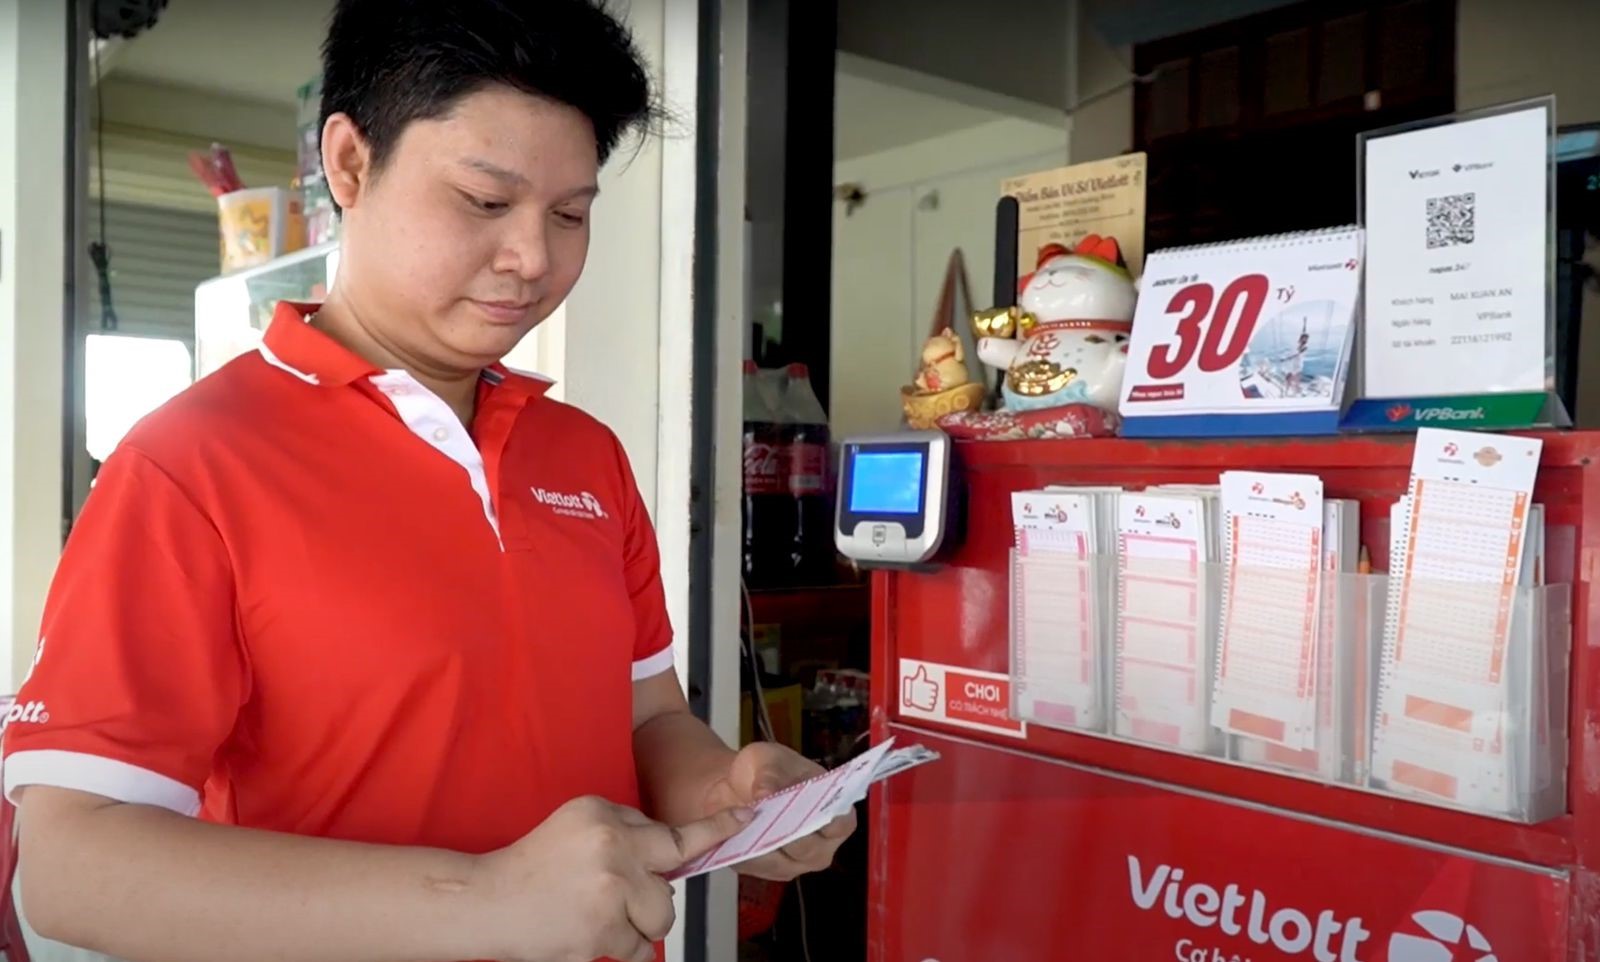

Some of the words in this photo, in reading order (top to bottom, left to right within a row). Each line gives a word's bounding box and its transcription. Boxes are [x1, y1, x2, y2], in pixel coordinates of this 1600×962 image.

[1450, 291, 1469, 301] MAI
[1498, 287, 1513, 297] AN
[1476, 310, 1513, 321] VPBank
[1147, 273, 1269, 380] 30
[1276, 285, 1296, 304] Tỷ
[1414, 405, 1485, 421] VPBank
[530, 486, 584, 510] Vietlott
[1127, 855, 1371, 962] Vietlott
